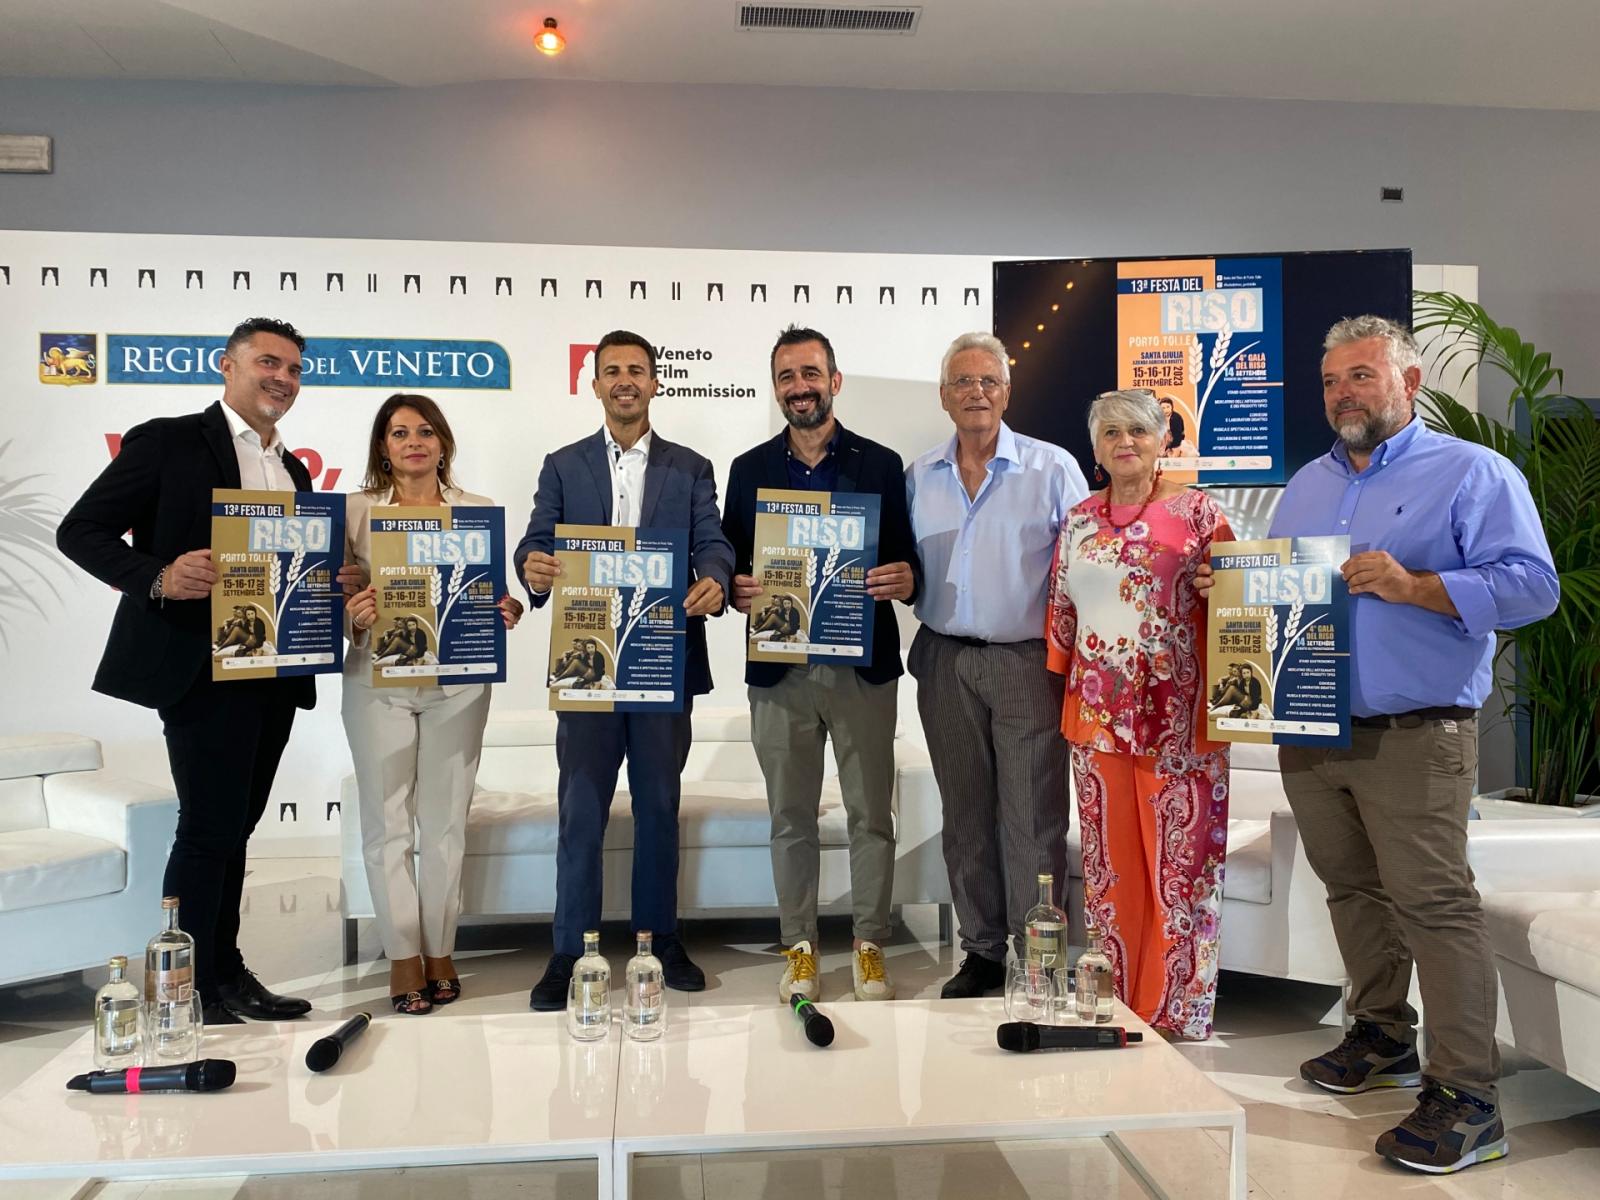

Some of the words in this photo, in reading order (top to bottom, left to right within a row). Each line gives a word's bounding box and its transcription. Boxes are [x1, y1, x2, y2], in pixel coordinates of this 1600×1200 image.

[1150, 278, 1180, 291] FESTA
[1182, 278, 1201, 290] DEL
[1167, 292, 1256, 331] RISO
[1129, 336, 1159, 346] PORTO
[1162, 335, 1191, 346] TOLLE
[653, 346, 712, 361] Veneto
[121, 346, 226, 374] REGIO
[348, 349, 496, 378] VENETO
[1133, 366, 1170, 377] 15-16-17
[1173, 366, 1183, 385] 2023
[1224, 366, 1233, 376] 14
[656, 383, 756, 398] Commission
[240, 505, 265, 515] FESTA
[267, 505, 282, 515] DEL
[780, 503, 803, 513] FESTA
[805, 504, 819, 514] DEL
[397, 520, 422, 530] FESTA
[424, 520, 440, 530] DEL
[255, 520, 325, 549] RISO
[793, 517, 859, 547] RISO
[412, 533, 485, 562] RISO
[581, 540, 606, 550] FESTA
[608, 540, 623, 550] DEL
[762, 546, 785, 554] PORTO
[787, 548, 809, 556] TOLLE
[221, 553, 246, 561] PORTO
[249, 553, 273, 562] TOLLE
[1235, 555, 1260, 567] FESTA
[1262, 554, 1278, 566] DEL
[380, 566, 405, 574] PORTO
[408, 566, 432, 574] TOLLE
[595, 554, 666, 585] RISO
[764, 570, 792, 579] 15-16-17
[224, 579, 255, 588] 15-16-17
[1249, 567, 1325, 603] RISO
[384, 591, 415, 600] 15-16-17
[562, 586, 587, 595] PORTO
[590, 587, 613, 596] TOLLE
[564, 612, 595, 621] 15-16-17
[1217, 607, 1241, 616] PORTO
[1244, 606, 1268, 616] TOLLE
[1220, 635, 1250, 644] 15-16-17
